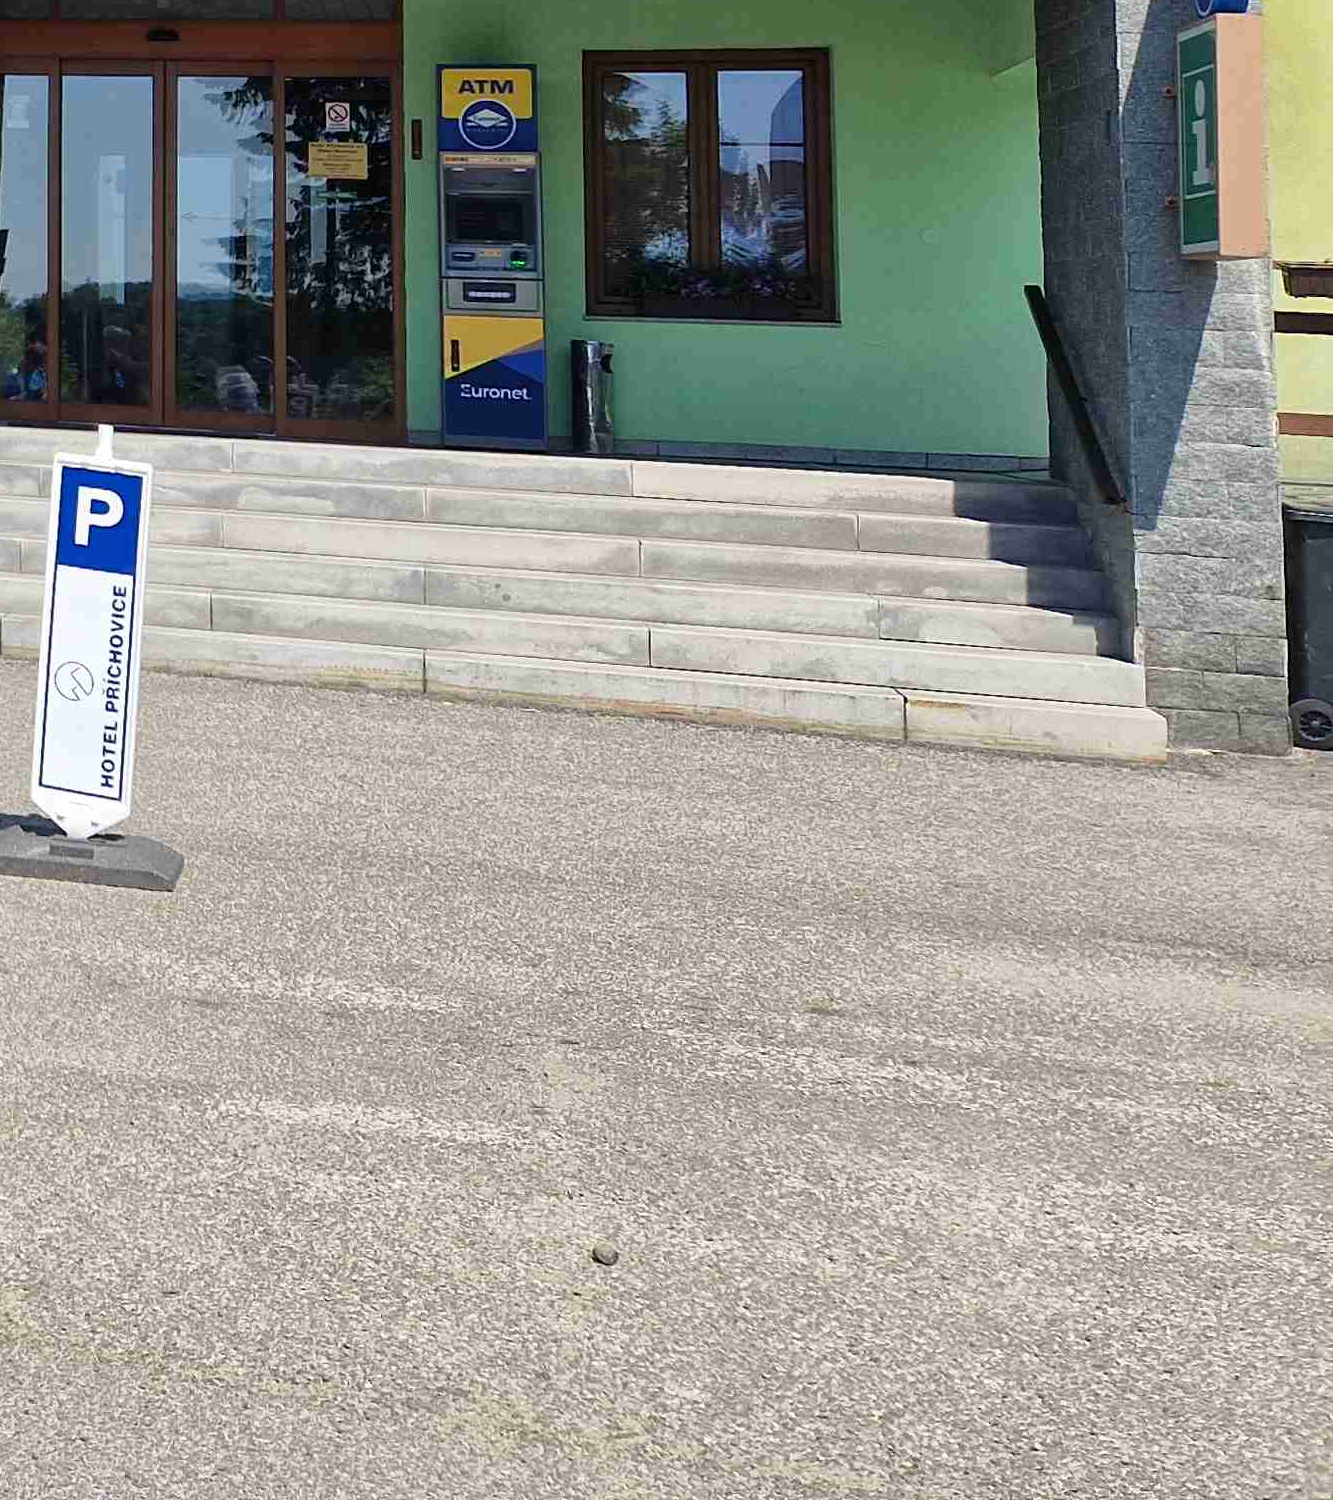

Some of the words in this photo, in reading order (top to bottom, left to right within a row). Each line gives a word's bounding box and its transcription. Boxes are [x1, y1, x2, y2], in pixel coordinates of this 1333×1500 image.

[457, 79, 514, 94] ATM
[460, 383, 532, 400] Euronet
[73, 485, 125, 547] P
[101, 585, 127, 714] PŘÍCHOVICE
[100, 721, 118, 789] HOTEL
